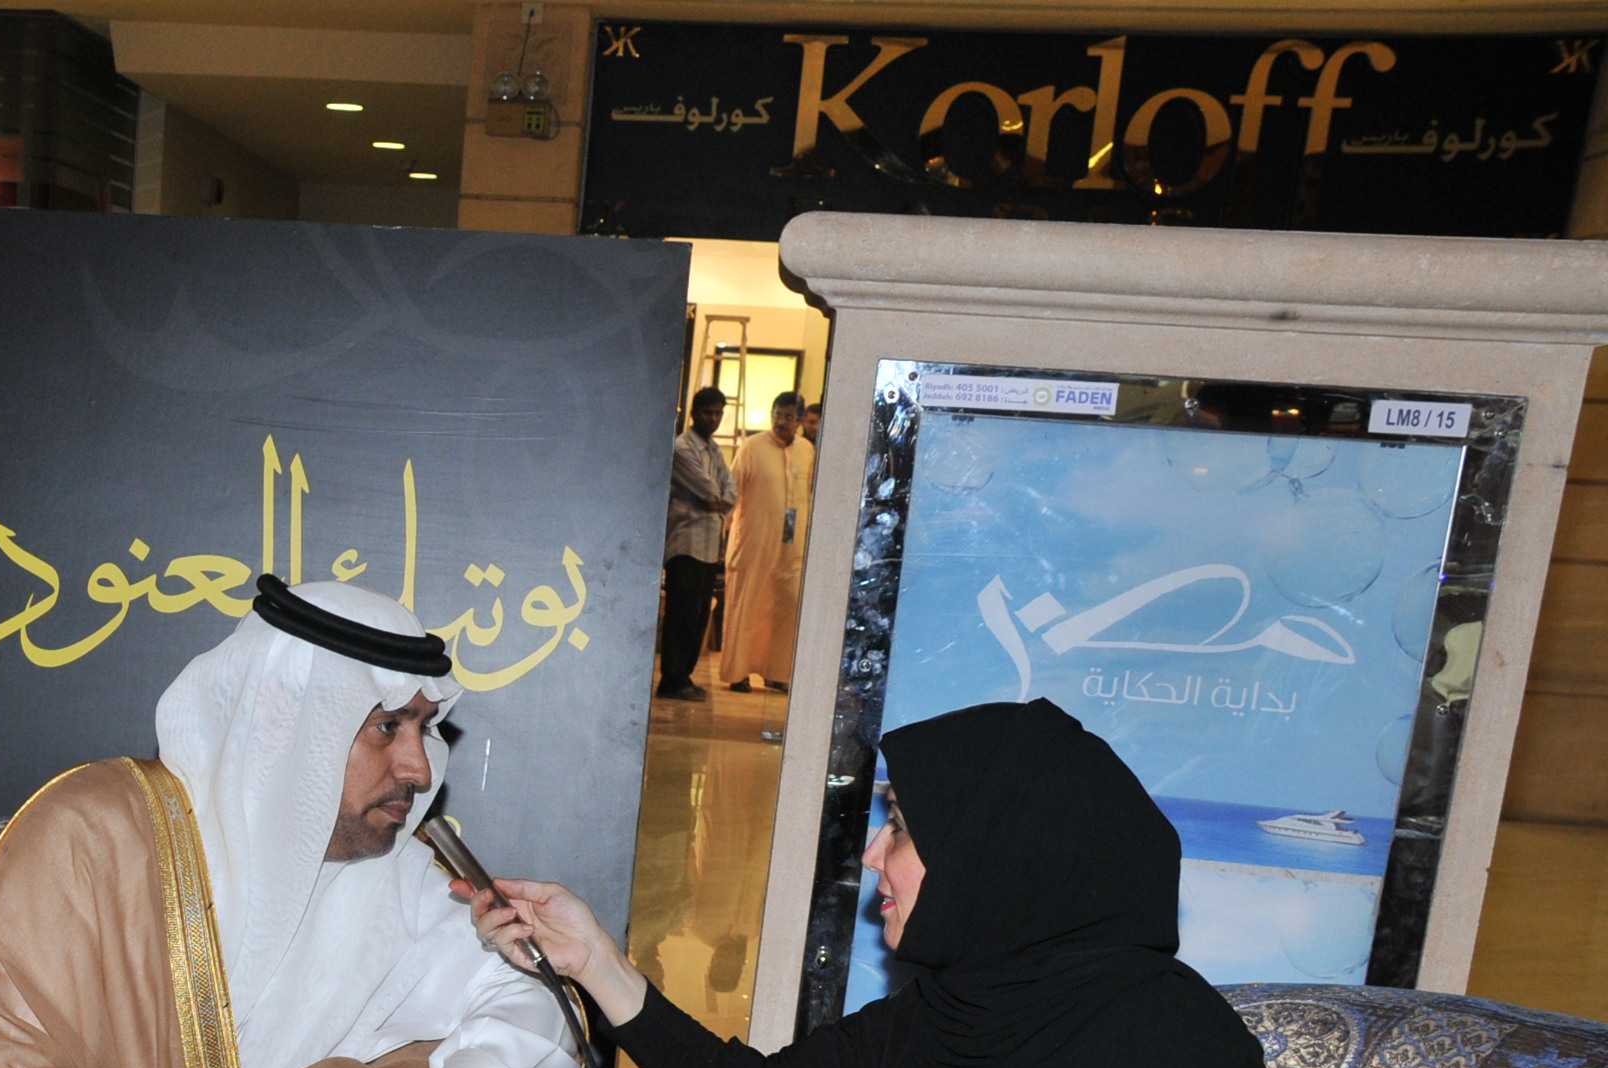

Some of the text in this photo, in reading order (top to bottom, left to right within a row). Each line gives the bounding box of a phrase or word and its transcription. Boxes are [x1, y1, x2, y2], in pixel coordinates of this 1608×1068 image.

[610, 95, 774, 132] كورلوف
[769, 34, 1396, 197] Korloff
[1341, 112, 1560, 162] كورلوف
[955, 393, 973, 401] 692
[975, 394, 999, 403] 8186
[956, 383, 973, 391] 405
[975, 384, 999, 393] 5001
[1055, 389, 1113, 405] FADEN
[1385, 408, 1421, 427] LM8
[1436, 410, 1456, 429] 15
[1081, 667, 1298, 721] بداية الحكاية
